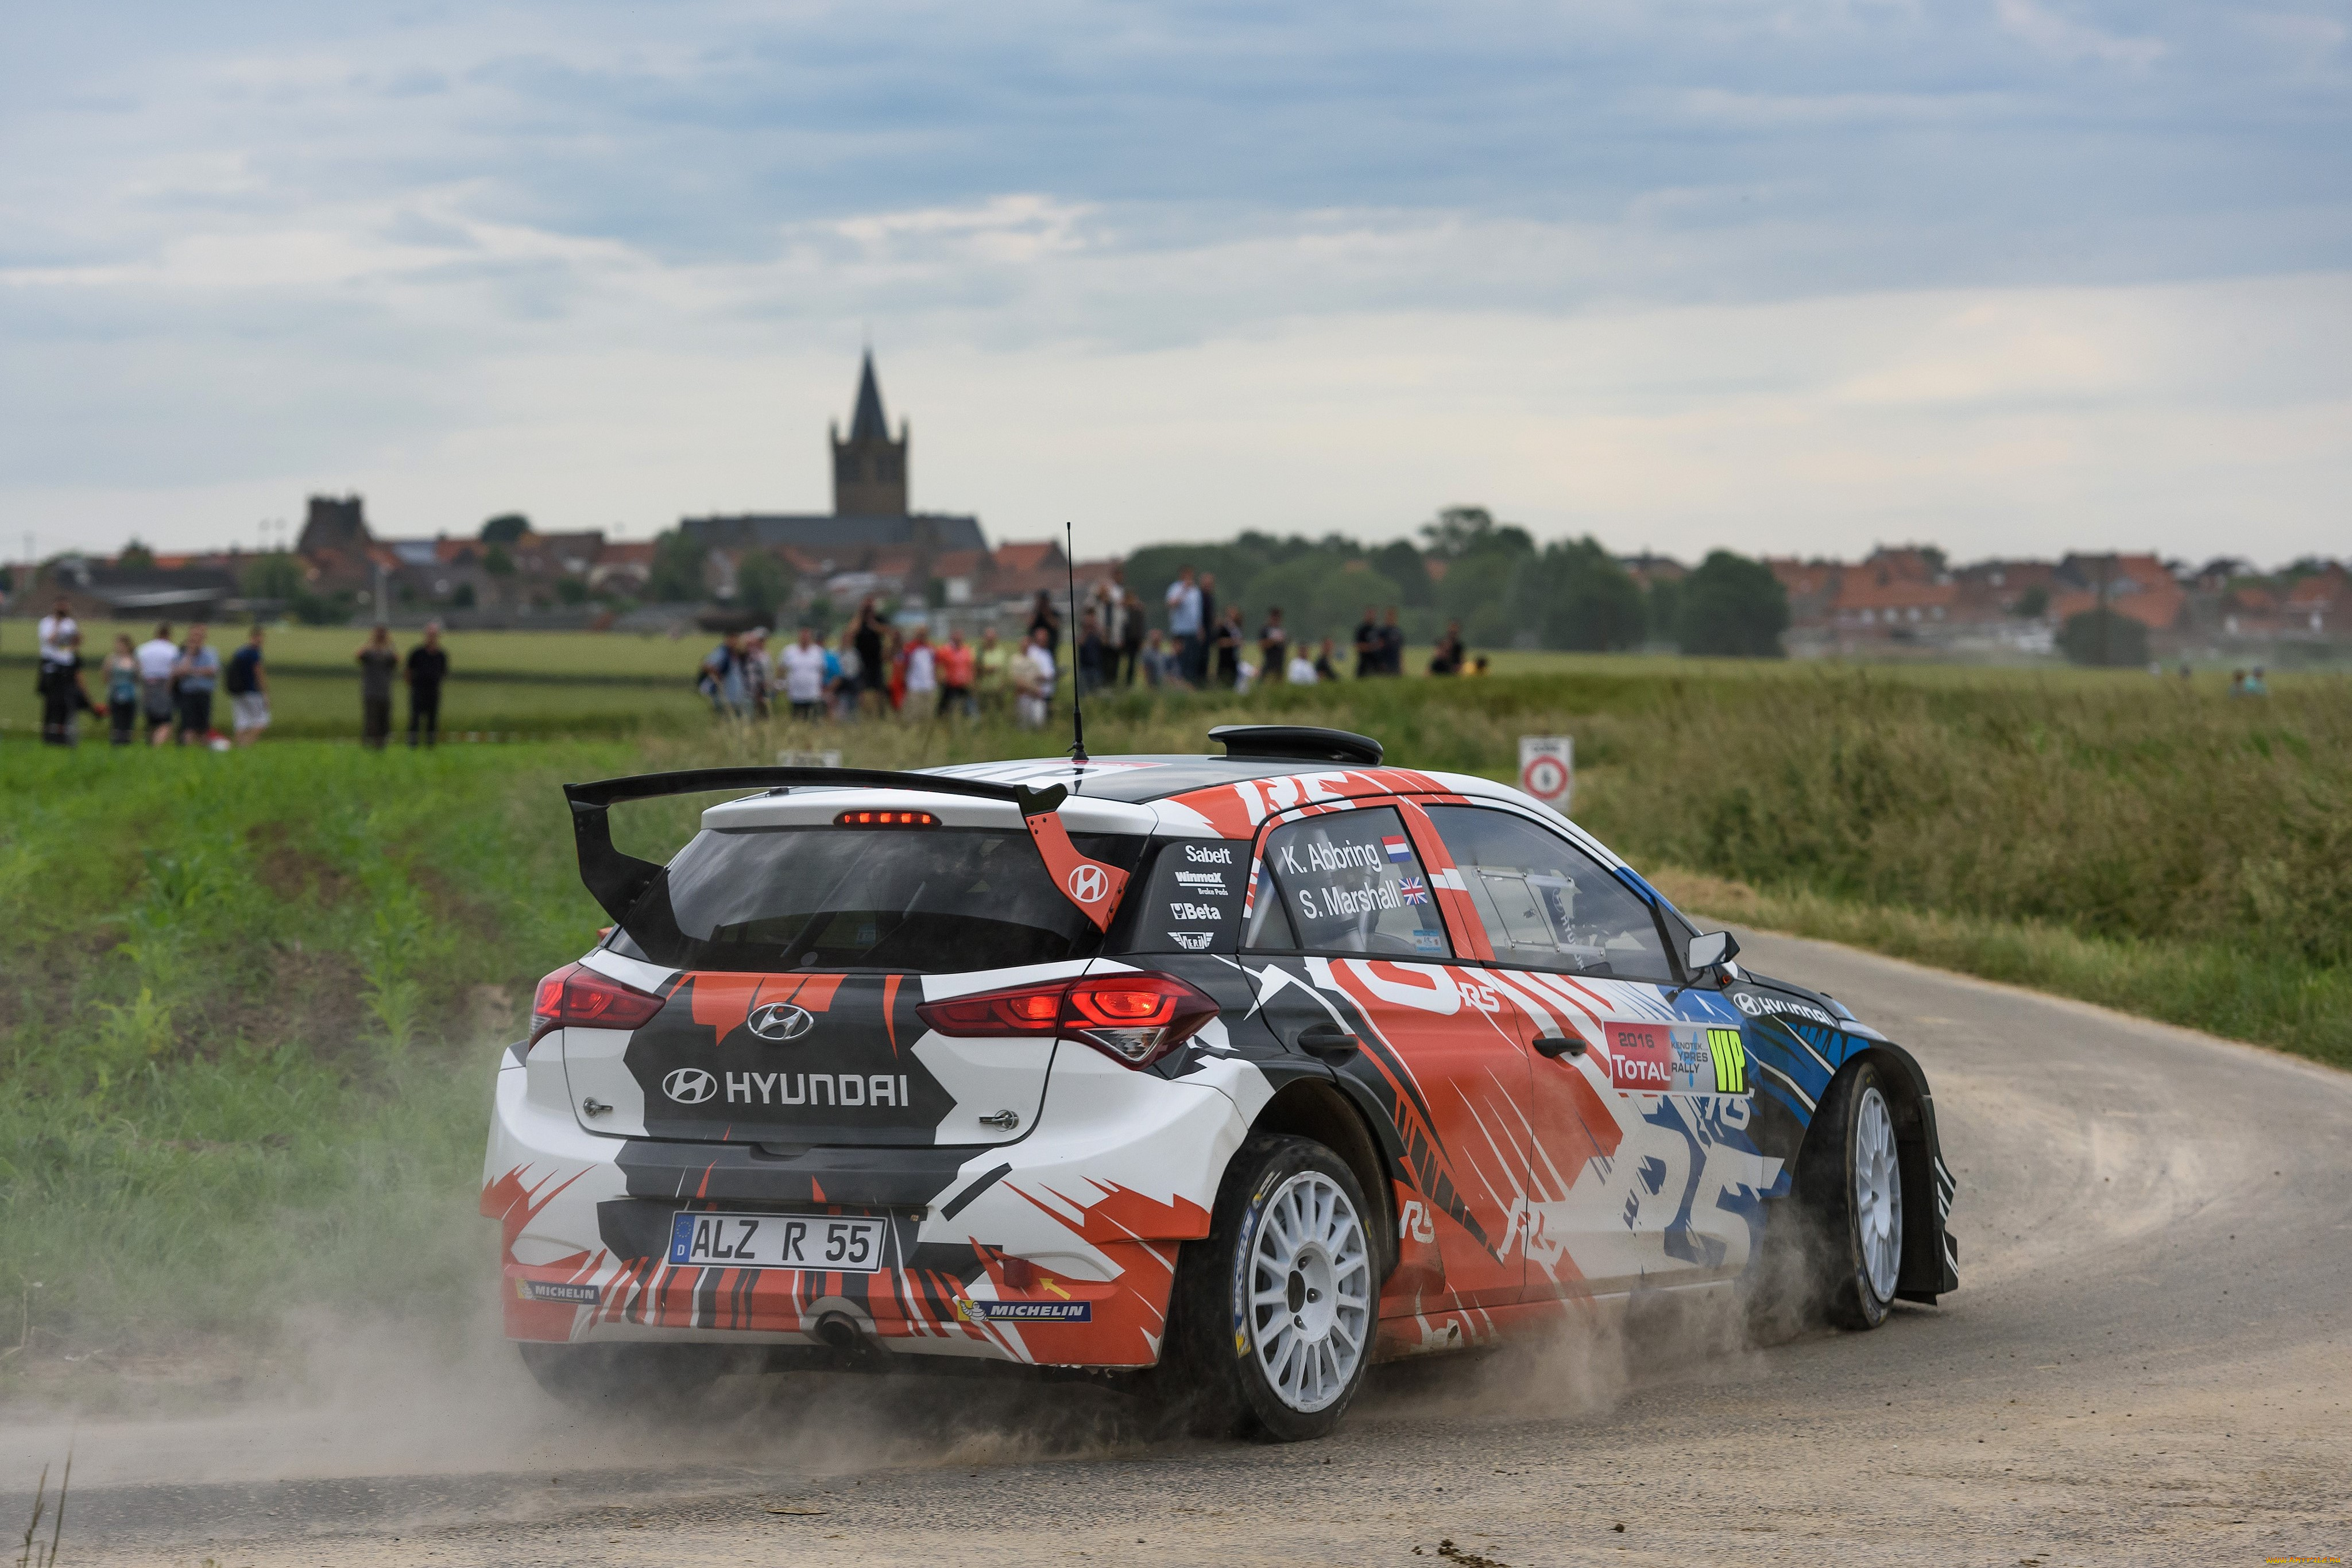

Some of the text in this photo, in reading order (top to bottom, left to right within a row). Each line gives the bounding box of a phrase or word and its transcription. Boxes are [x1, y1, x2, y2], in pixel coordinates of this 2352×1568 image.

[1185, 845, 1232, 864] Sabelt
[1281, 839, 1382, 874] K. Abbring
[1299, 880, 1401, 920] S. Marshall
[1183, 903, 1221, 919] Beta
[1618, 1032, 1655, 1048] 2016
[1671, 1042, 1703, 1050] KENOTEK
[1678, 1052, 1708, 1062] YPRES
[1707, 1029, 1746, 1092] VIP
[1671, 1063, 1700, 1073] RALLY
[726, 1071, 909, 1107] HYUNDAI
[691, 1219, 871, 1263] ALZ R 55
[677, 1244, 685, 1256] D
[536, 1286, 594, 1299] MICHELIN
[991, 1305, 1084, 1318] MICHELIN
